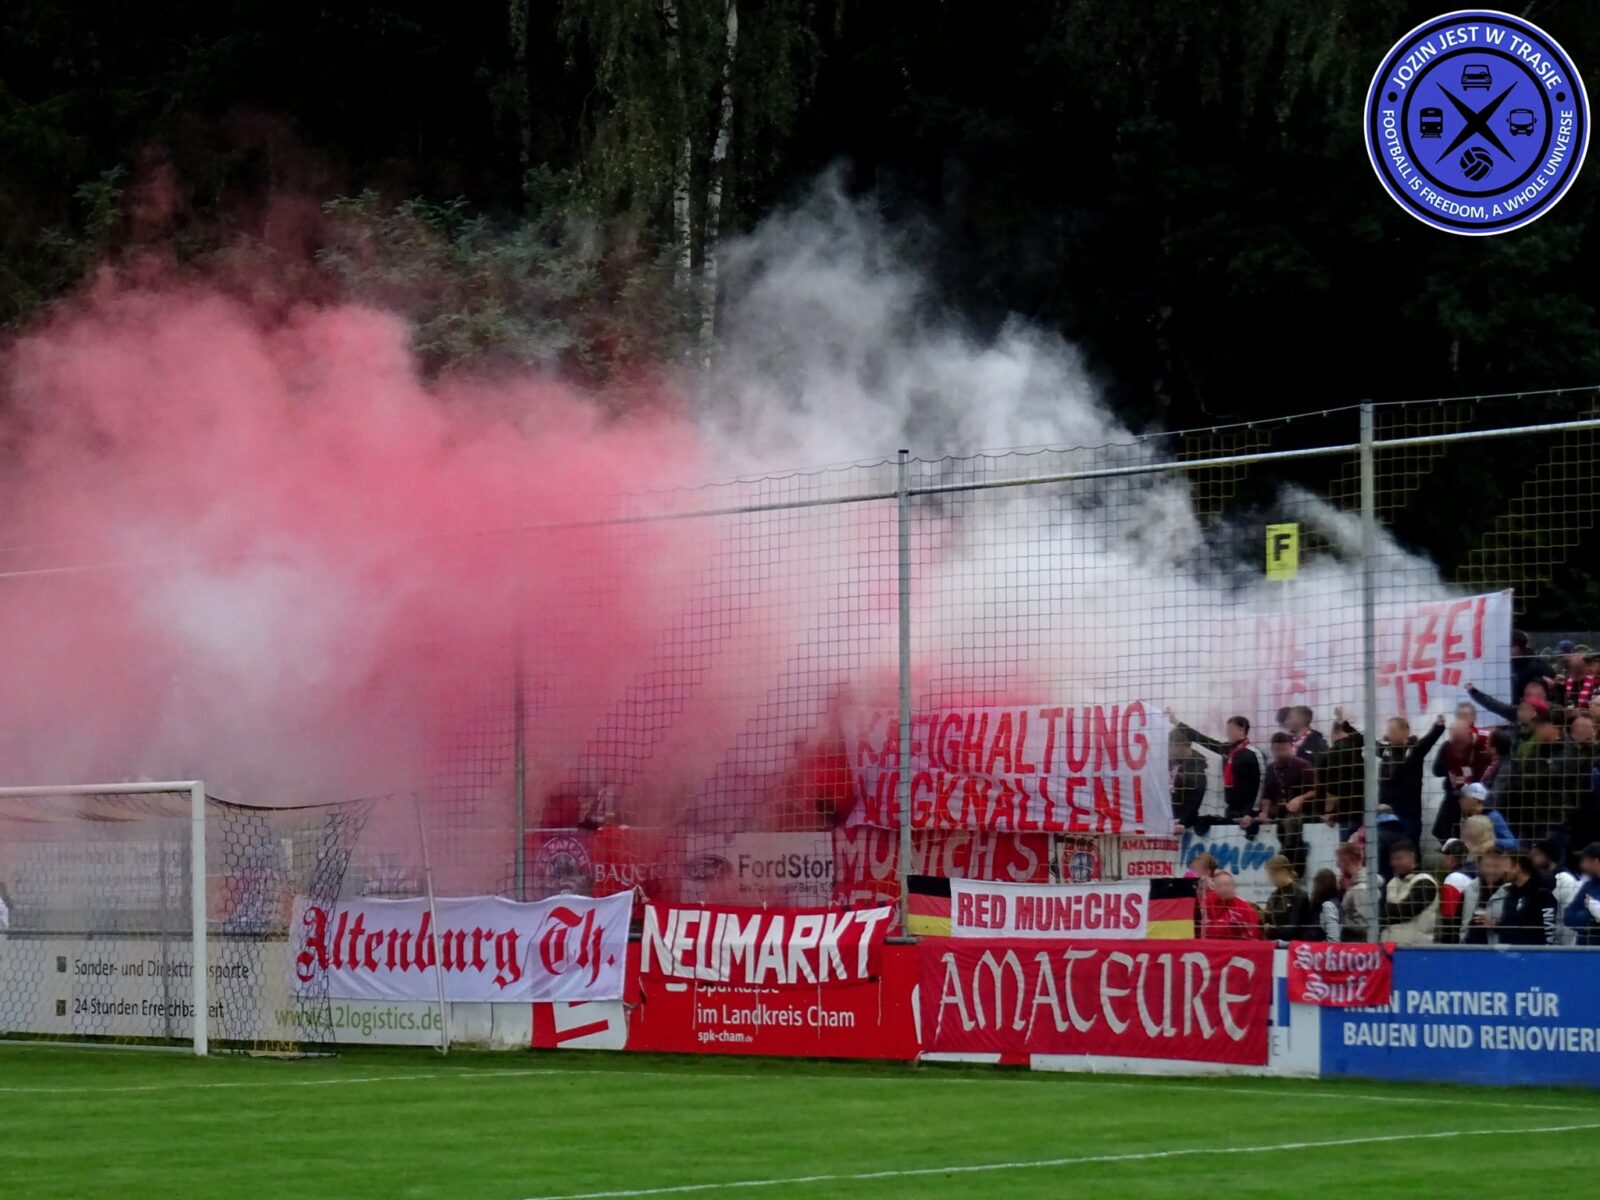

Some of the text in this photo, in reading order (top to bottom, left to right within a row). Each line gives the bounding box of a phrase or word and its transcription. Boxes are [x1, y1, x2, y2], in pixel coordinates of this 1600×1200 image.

[1273, 533, 1291, 561] F
[1127, 861, 1172, 876] GEGEN
[957, 892, 1007, 929] RED
[296, 906, 521, 989] Altenburg
[640, 904, 892, 984] NEUMARKT
[74, 959, 118, 976] Sonder-
[121, 961, 144, 977] und
[74, 998, 88, 1014] 24
[91, 999, 139, 1016] Stunden
[935, 947, 1255, 1045] AMATEURE
[1406, 990, 1507, 1017] PARTNER
[1515, 986, 1559, 1018] FÜR
[697, 1003, 855, 1027] im Landkreis Cham
[1343, 1022, 1417, 1048] BAUEN
[1424, 1024, 1474, 1049] UND
